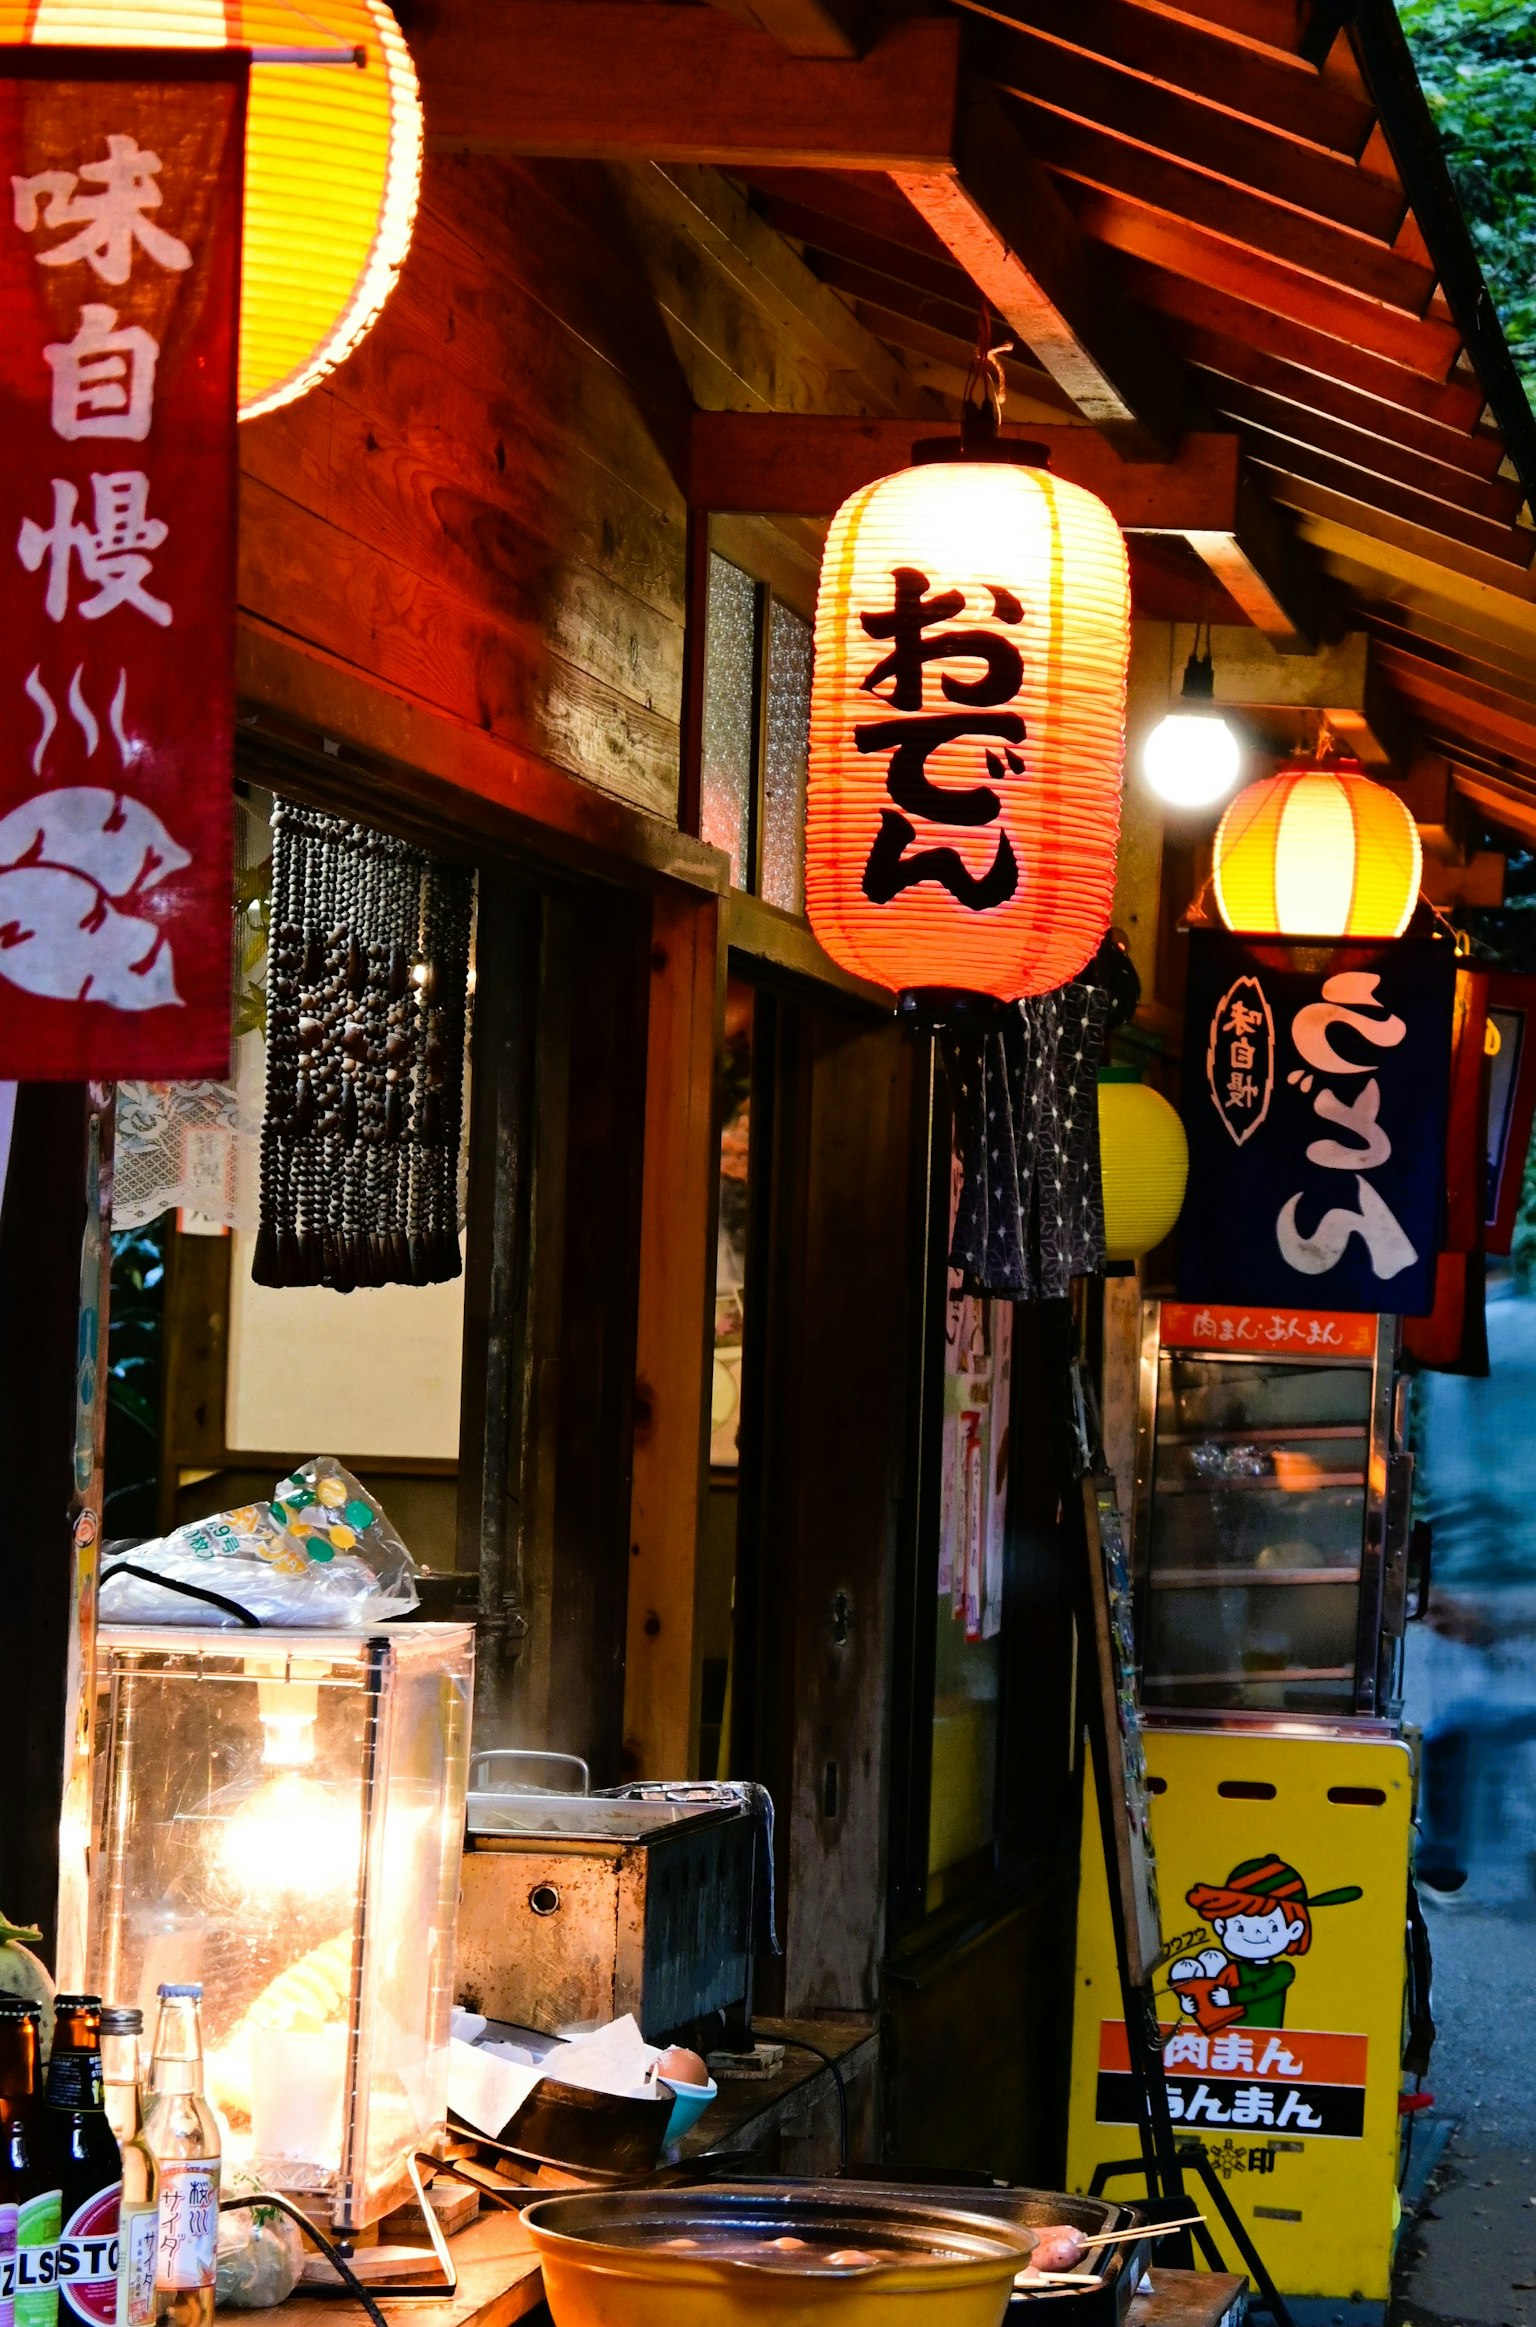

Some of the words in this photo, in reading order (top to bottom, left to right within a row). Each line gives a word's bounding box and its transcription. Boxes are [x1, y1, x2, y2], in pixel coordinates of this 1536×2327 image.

[11, 134, 193, 628] 味自慢
[854, 566, 1027, 912] おでん
[205, 1521, 240, 1555] .9号
[1164, 2032, 1303, 2076] 肉まん
[160, 2190, 185, 2279] サイダー
[188, 2181, 210, 2234] 桜川
